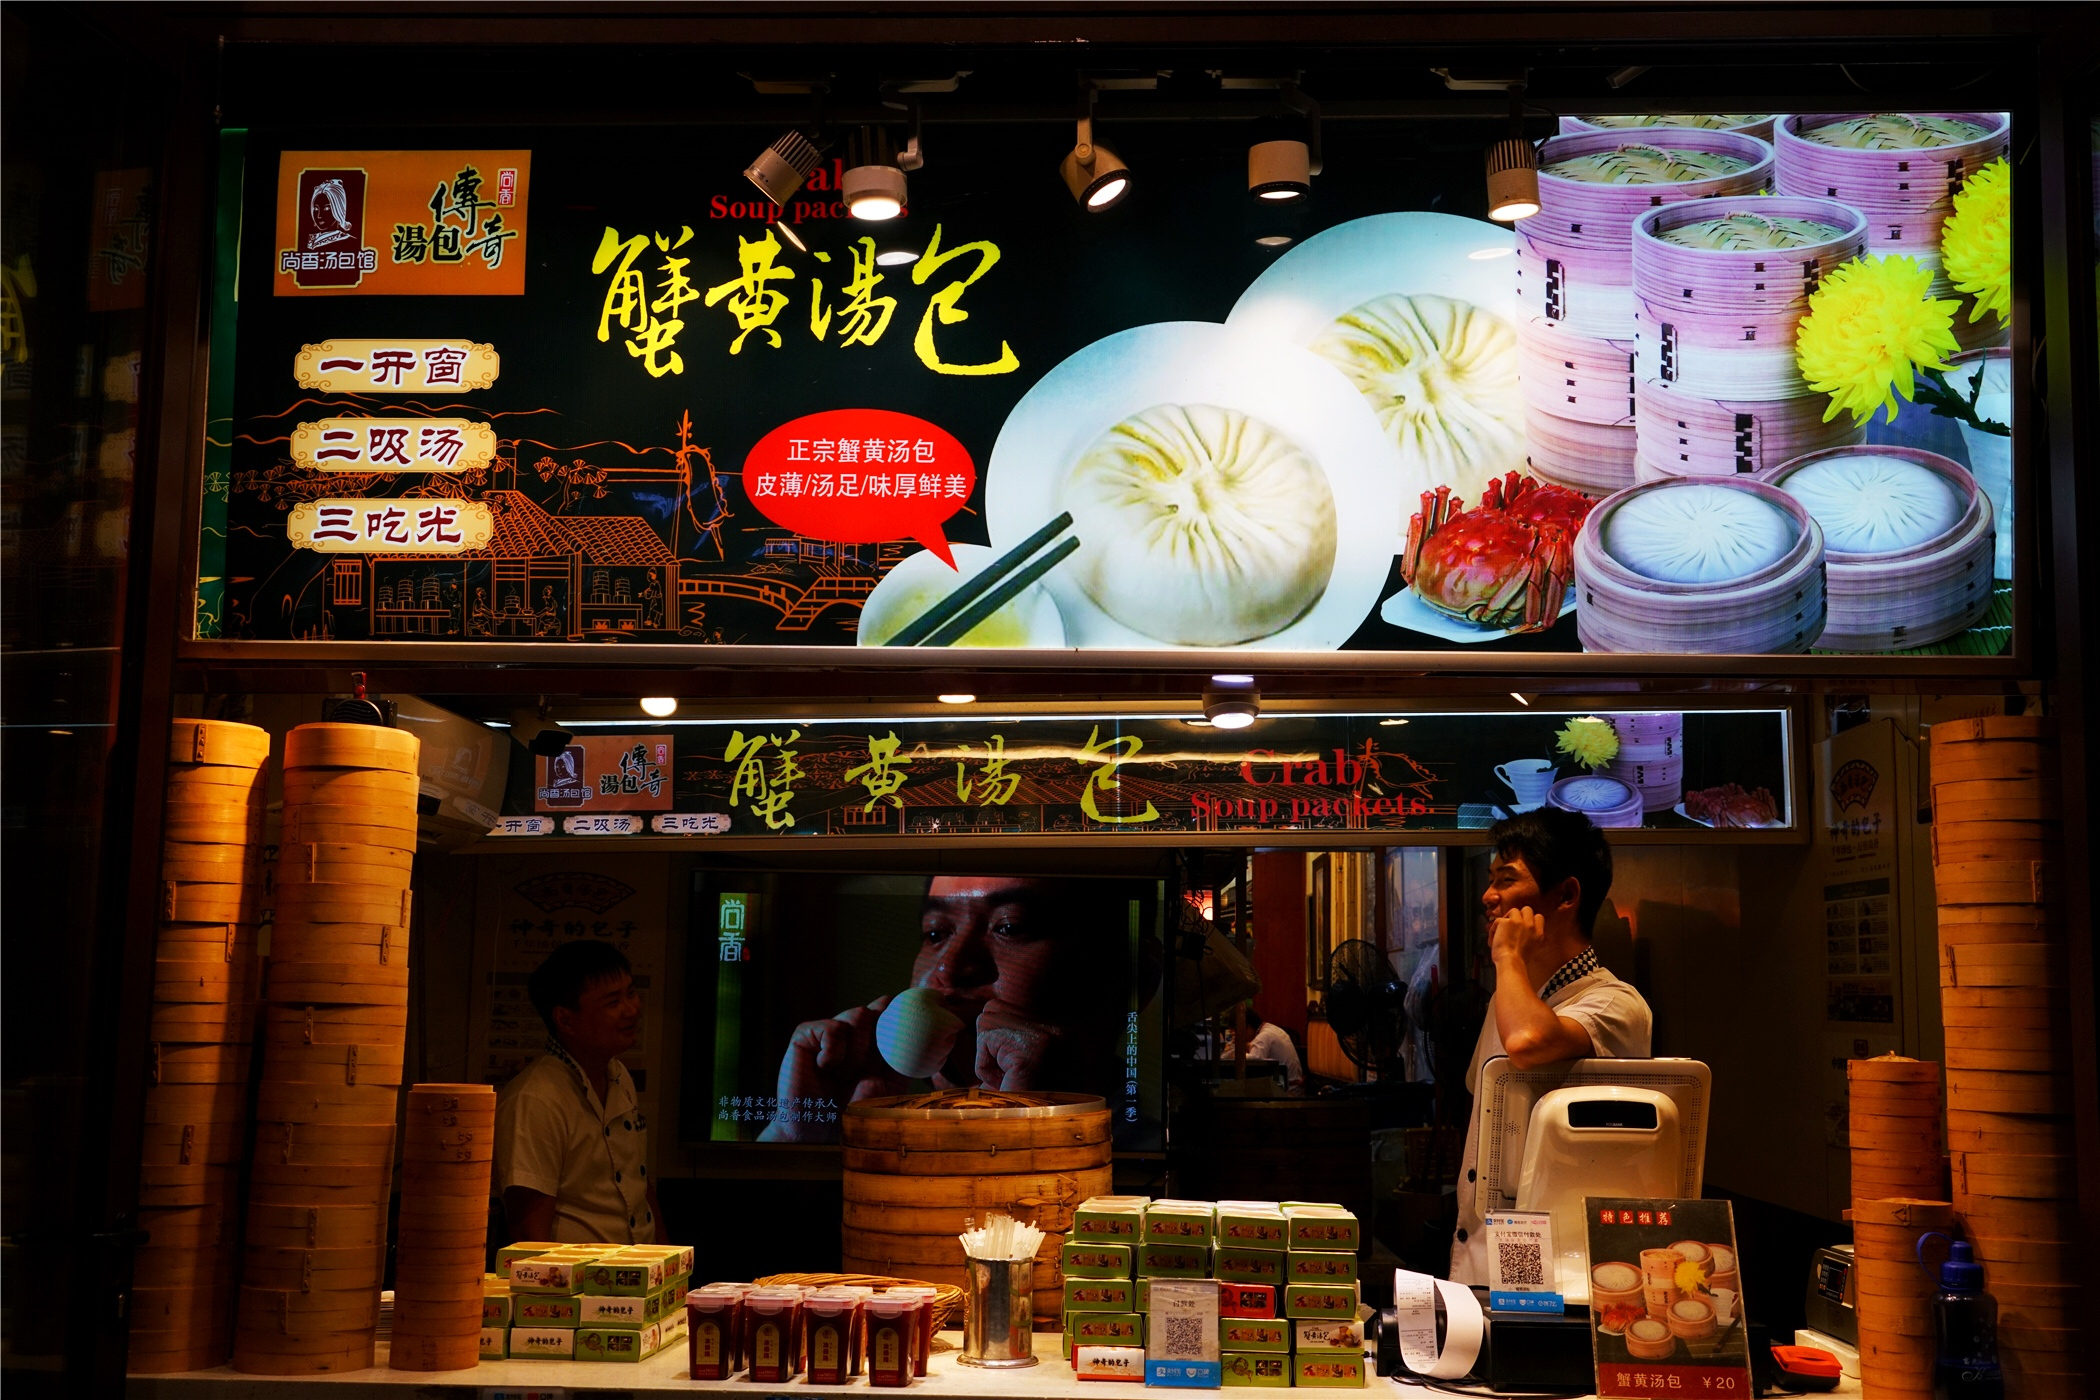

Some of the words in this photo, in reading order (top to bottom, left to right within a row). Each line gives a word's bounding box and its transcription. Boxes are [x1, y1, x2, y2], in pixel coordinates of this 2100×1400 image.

[709, 195, 783, 225] Soup
[282, 251, 377, 270] 尚香汤包馆
[321, 348, 467, 385] 一开窗
[317, 428, 463, 466] 二吸汤
[787, 438, 935, 463] 正宗蟹黄汤包
[755, 472, 966, 498] 皮薄/汤足/味厚鲜美
[314, 506, 462, 544] 三吃光
[1241, 748, 1362, 786] Crab
[539, 788, 592, 799] 尚香汤包馆
[1190, 791, 1278, 823] Soup
[1289, 791, 1427, 823] packets
[573, 818, 631, 832] 二吸汤
[661, 816, 720, 829] 三吃光
[508, 919, 638, 938] 神奇的包子
[718, 898, 746, 962] 尚香
[718, 1095, 838, 1109] 非物质文化遗产传承人
[1602, 1211, 1670, 1225] 特色推荐
[598, 1305, 634, 1315] 神奇的包子
[527, 1337, 563, 1346] 神奇的包子
[1092, 1358, 1130, 1367] 神奇的包子
[1617, 1372, 1682, 1388] 蟹黄汤包
